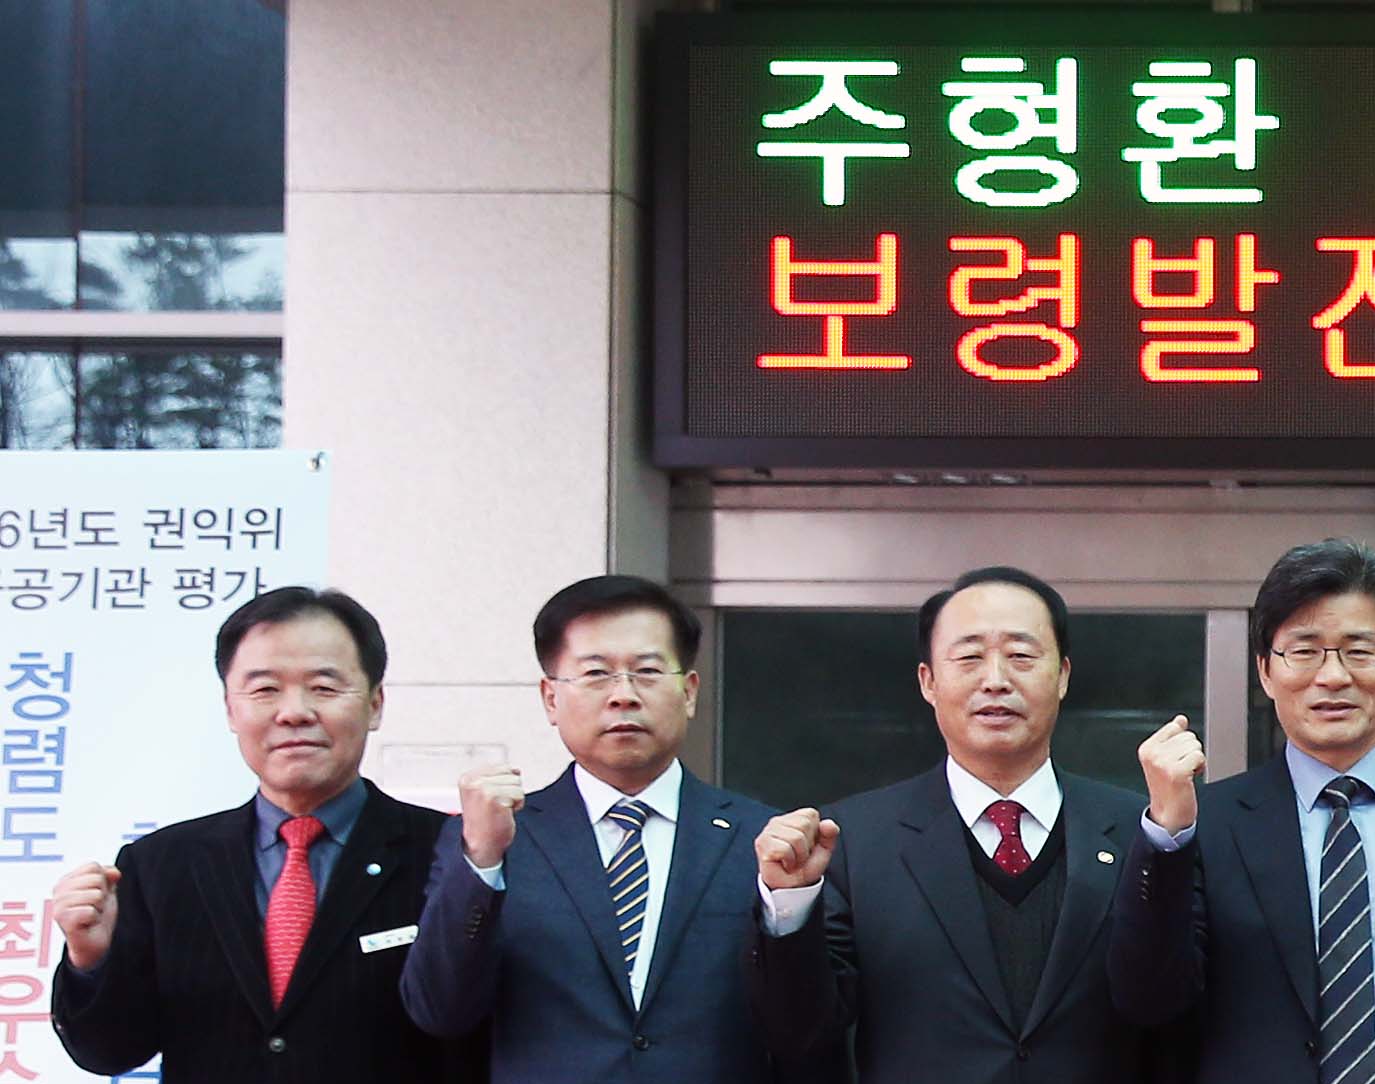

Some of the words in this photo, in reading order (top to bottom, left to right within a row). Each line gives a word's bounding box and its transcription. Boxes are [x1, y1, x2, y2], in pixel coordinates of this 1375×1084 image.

[755, 56, 1281, 207] 주형환
[143, 507, 281, 550] 권익위
[0, 566, 152, 610] 공기관
[173, 566, 267, 610] 평가
[0, 651, 74, 863] 청렴도
